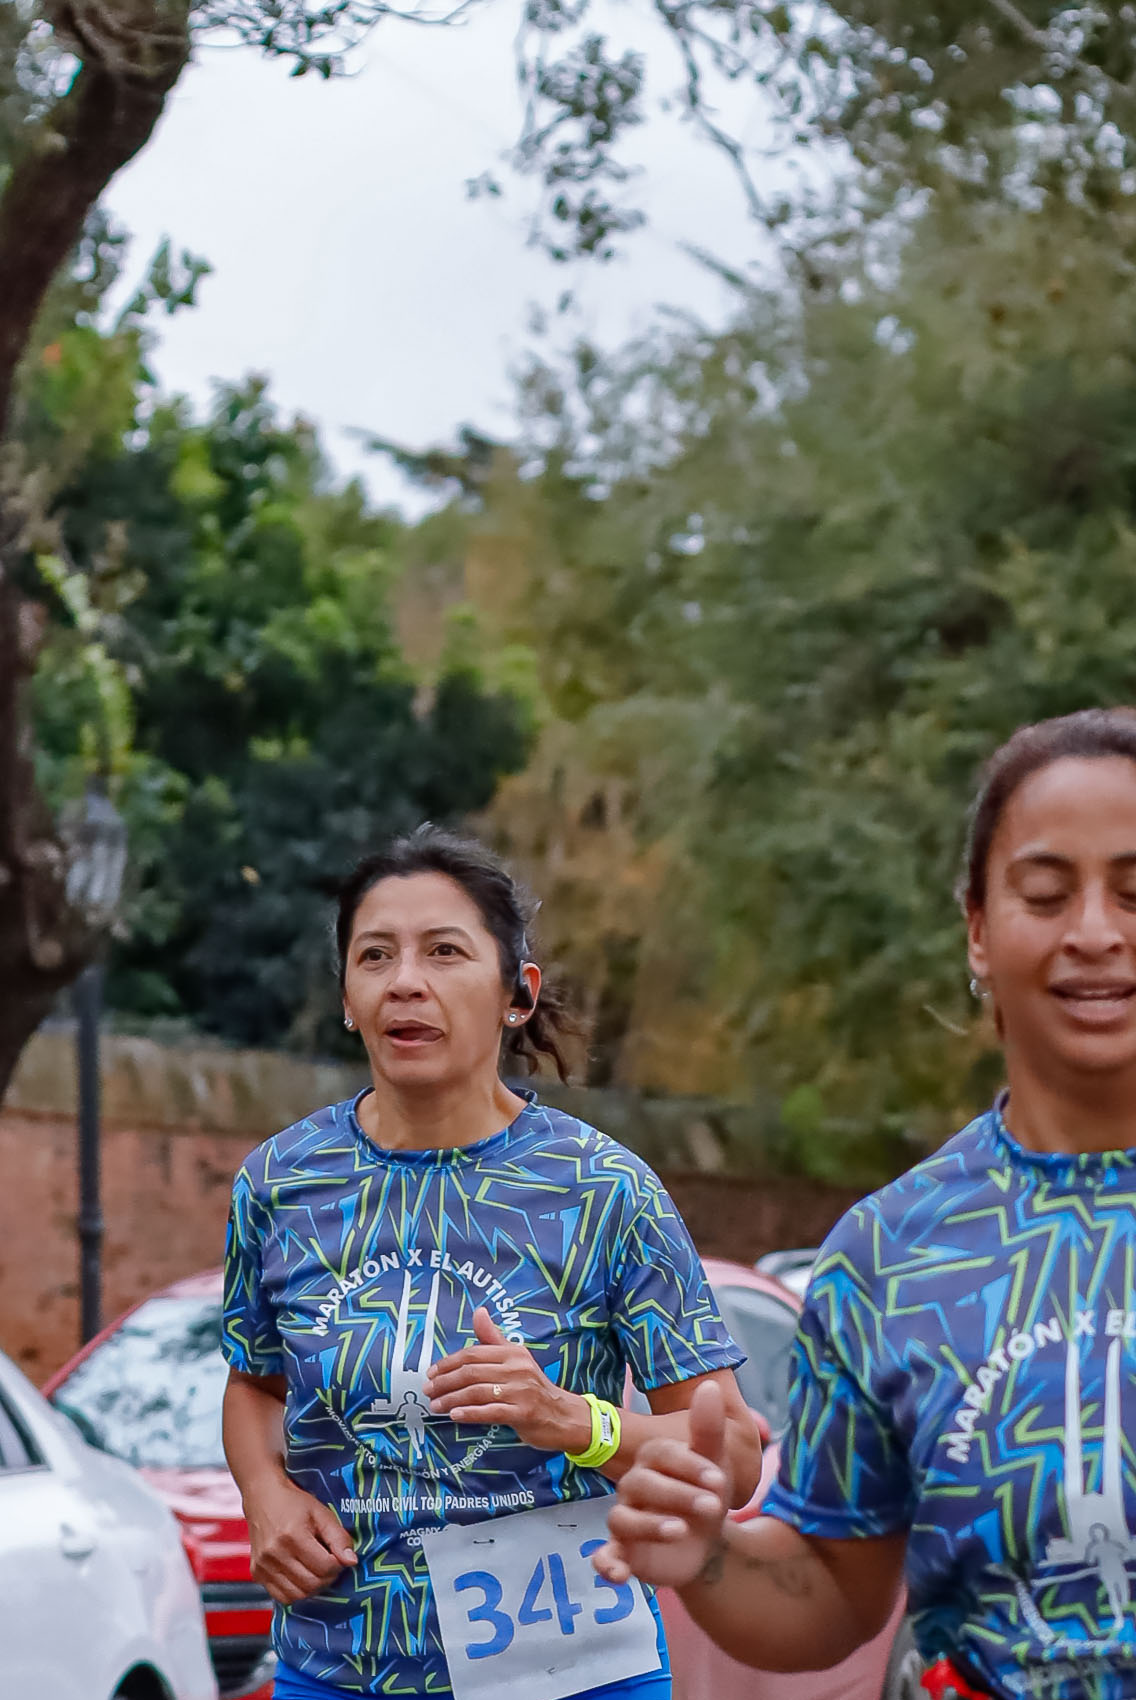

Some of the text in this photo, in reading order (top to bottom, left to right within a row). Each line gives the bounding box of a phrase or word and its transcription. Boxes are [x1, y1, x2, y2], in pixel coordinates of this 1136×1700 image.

[312, 1249, 524, 1346] MARATÓN X EL AUTISMO
[947, 1317, 1063, 1463] MARATÓN
[1073, 1309, 1097, 1337] X
[340, 1493, 390, 1513] ASOCIACIÓN
[391, 1496, 419, 1512] CIVIL
[444, 1496, 490, 1510] PADRES
[491, 1490, 535, 1507] UNIDOS
[454, 1539, 635, 1660] 343
